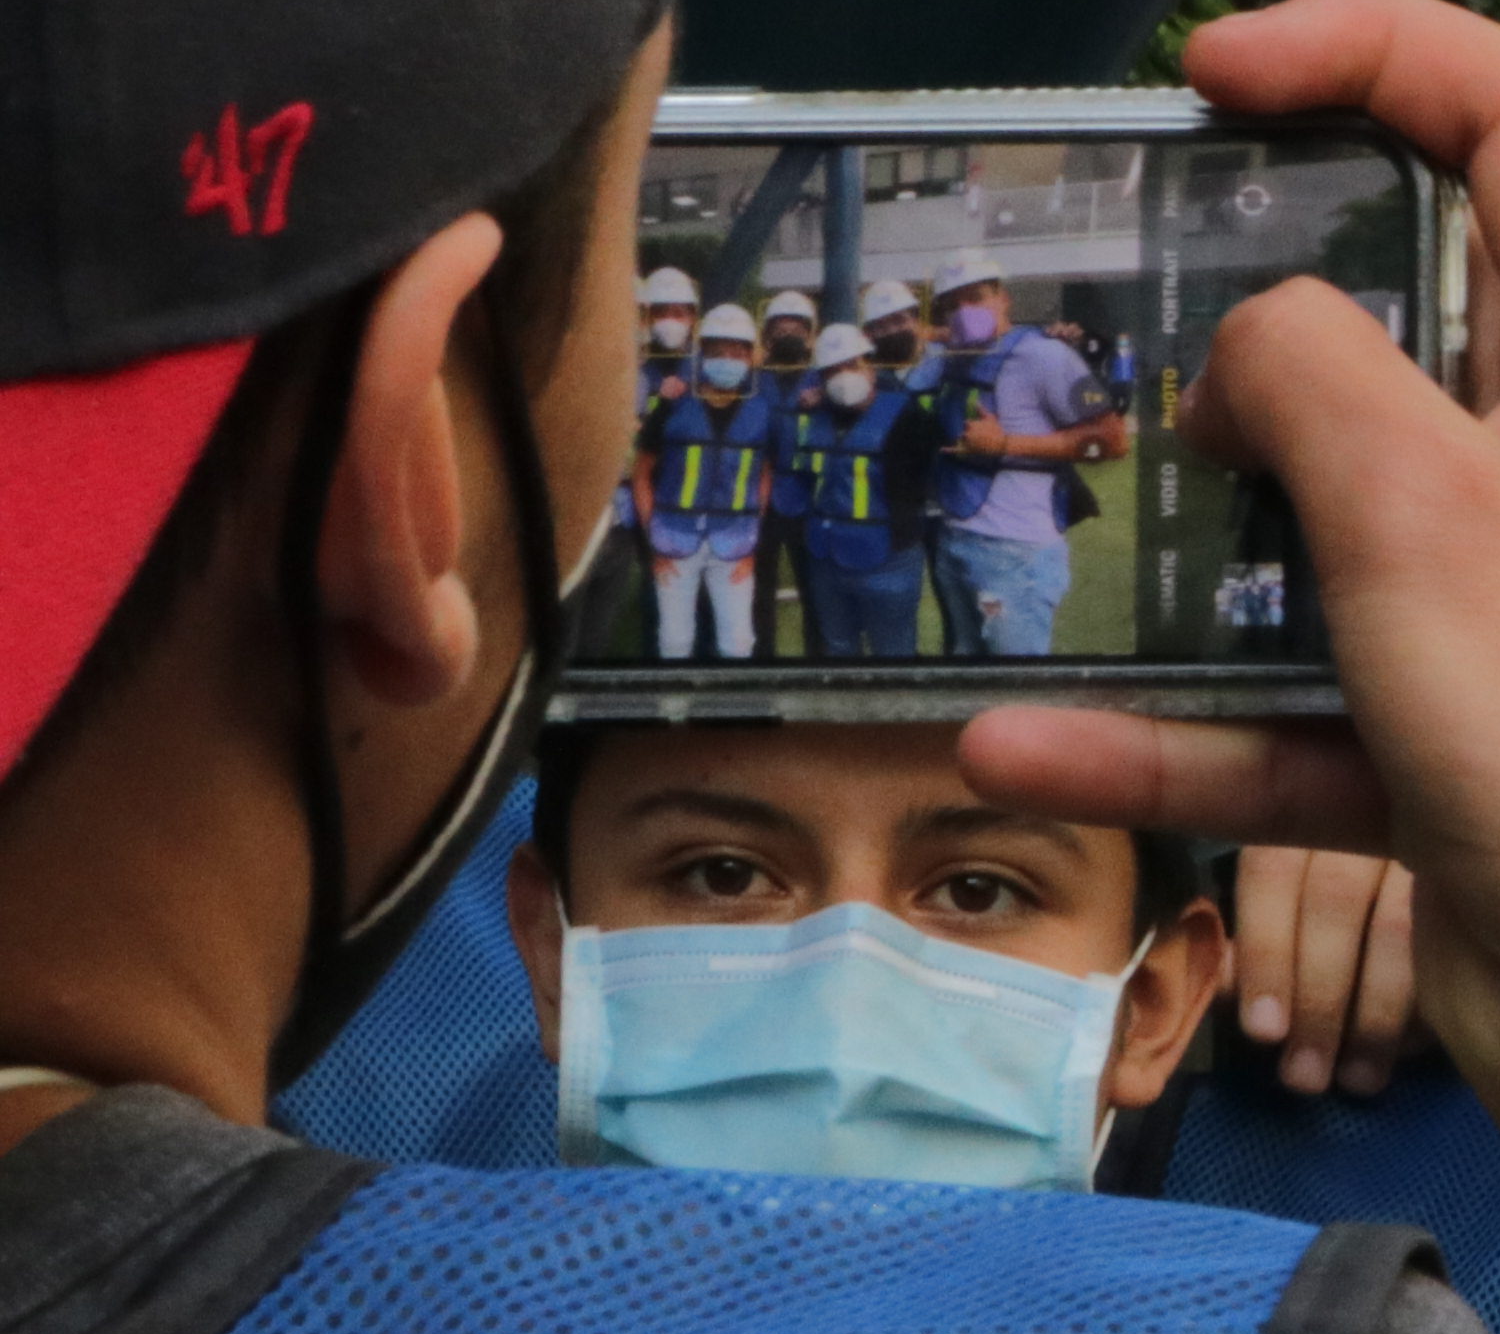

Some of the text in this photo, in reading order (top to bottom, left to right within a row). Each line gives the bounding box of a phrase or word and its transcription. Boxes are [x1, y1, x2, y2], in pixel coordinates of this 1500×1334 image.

[1161, 249, 1180, 335] PORTRAIT
[1161, 367, 1179, 430] PHOTO
[1160, 463, 1179, 517] VIDEO
